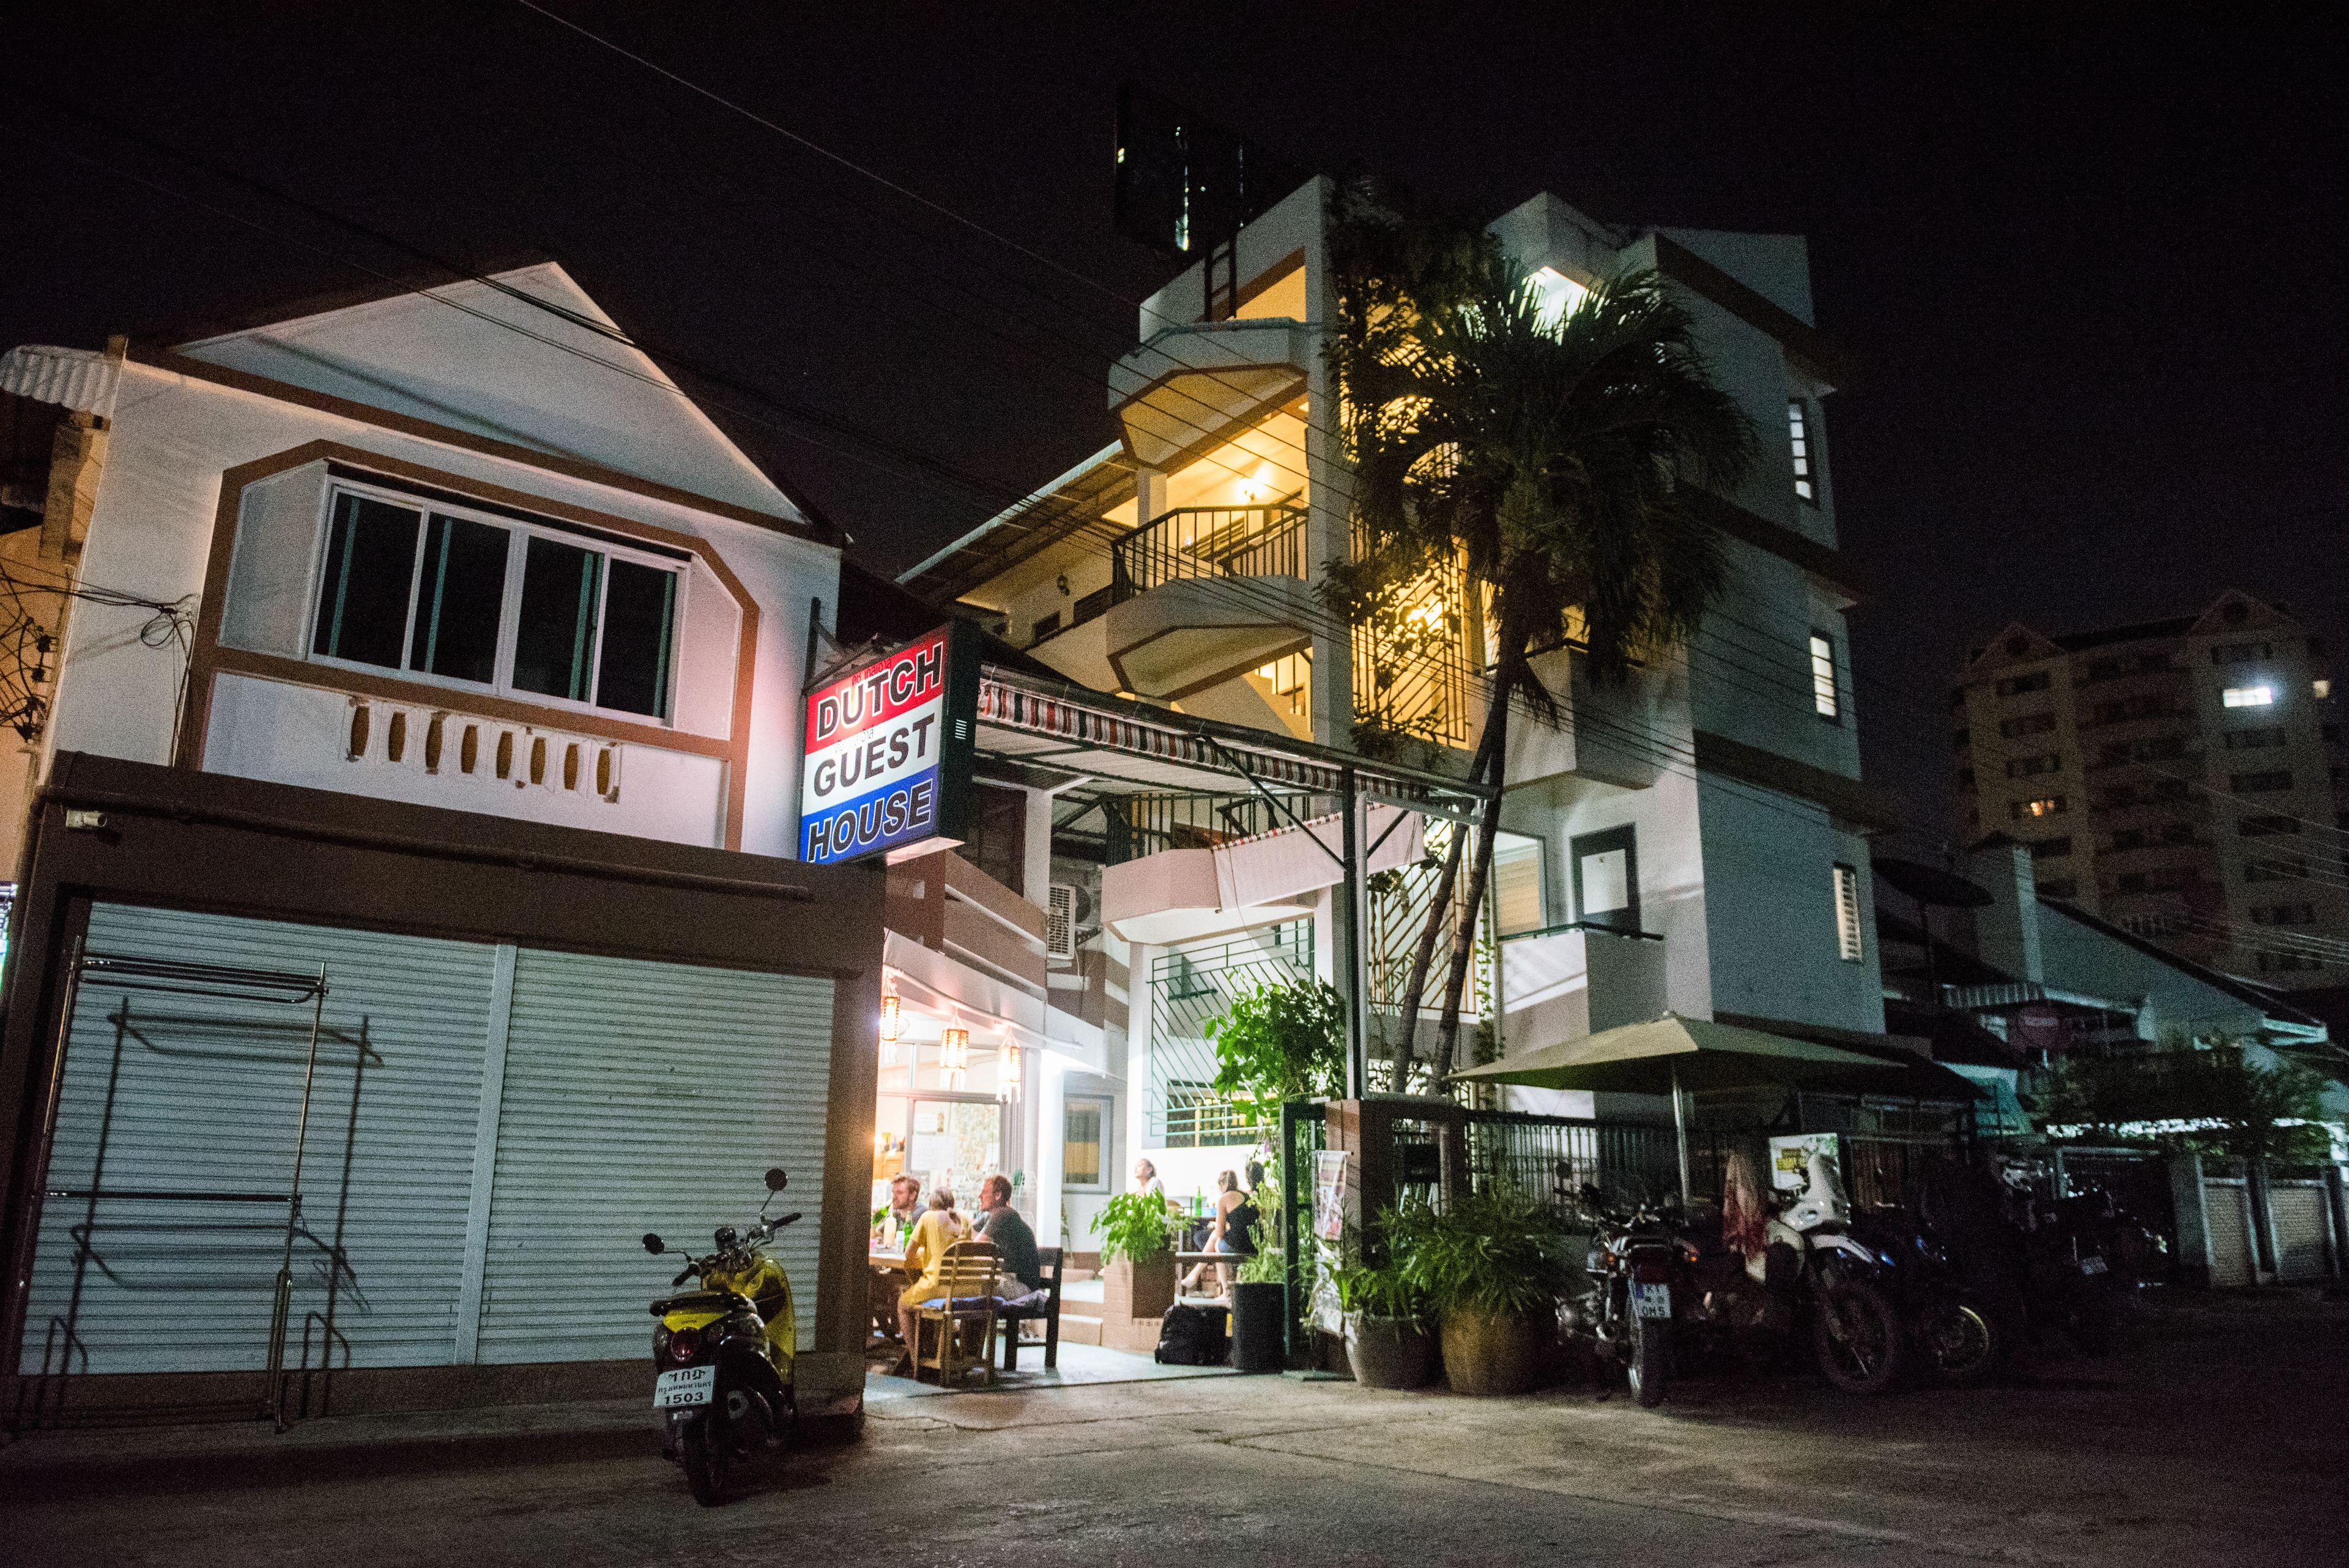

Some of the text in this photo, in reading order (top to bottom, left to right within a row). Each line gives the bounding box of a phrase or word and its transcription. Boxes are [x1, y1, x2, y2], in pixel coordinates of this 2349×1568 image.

[817, 641, 943, 741] DUTCH
[814, 712, 935, 797] GUEST
[807, 778, 933, 863] HOUSE
[665, 1392, 703, 1405] 1503
